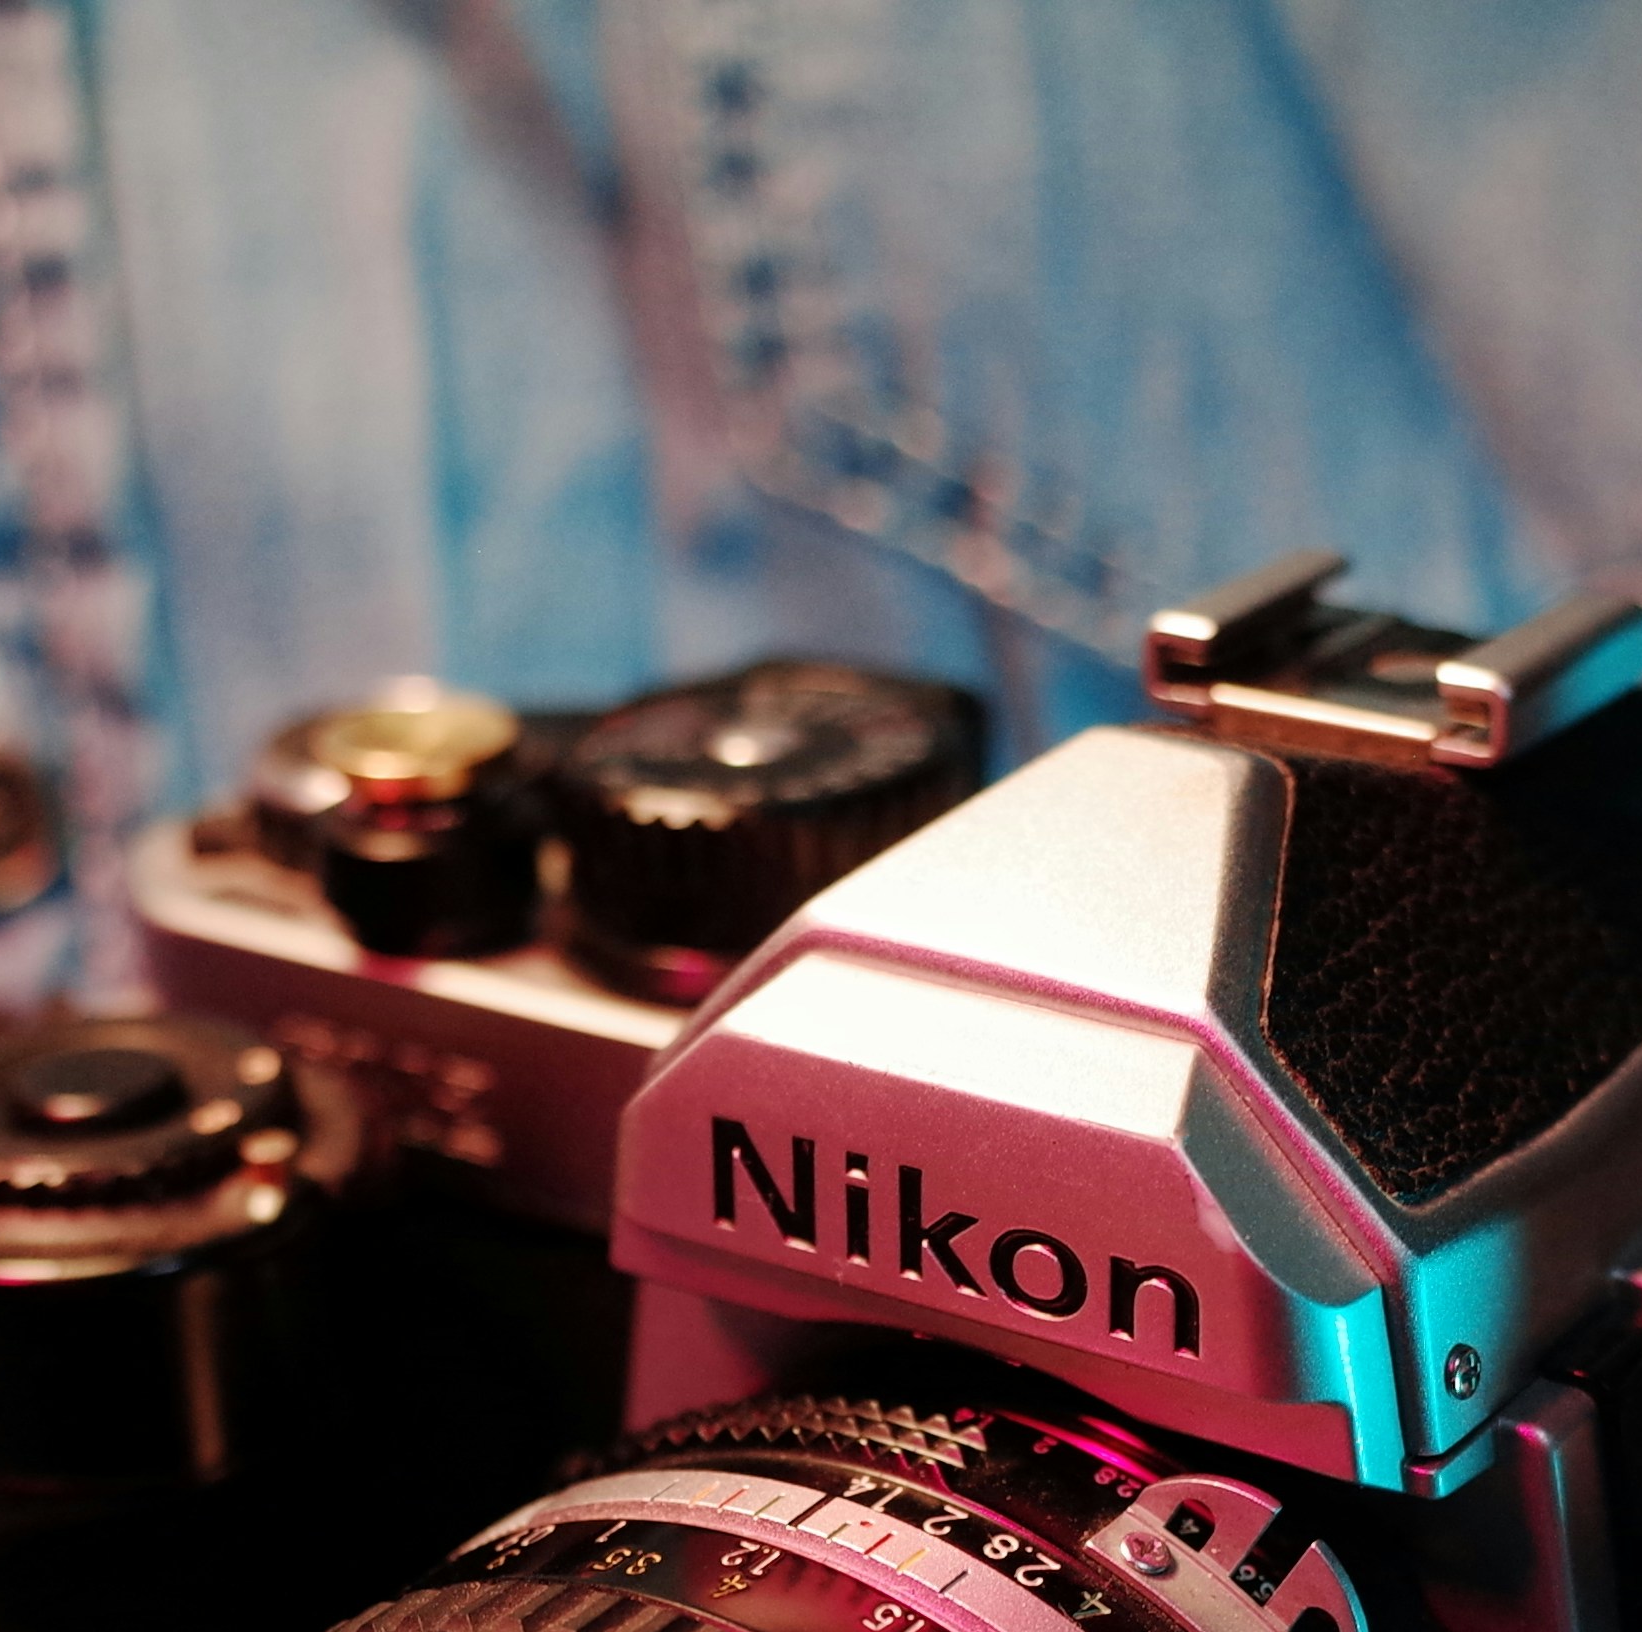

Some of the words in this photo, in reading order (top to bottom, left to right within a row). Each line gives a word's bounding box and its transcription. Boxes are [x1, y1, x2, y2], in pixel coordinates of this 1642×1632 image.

[710, 1113, 1203, 1361] Nikon
[1093, 1464, 1143, 1498] 2.8
[720, 1540, 781, 1576] 1.2
[843, 1476, 904, 1512] 1.4
[920, 1503, 969, 1537] 2
[982, 1532, 1062, 1588] 2.8
[1071, 1588, 1113, 1624] 4
